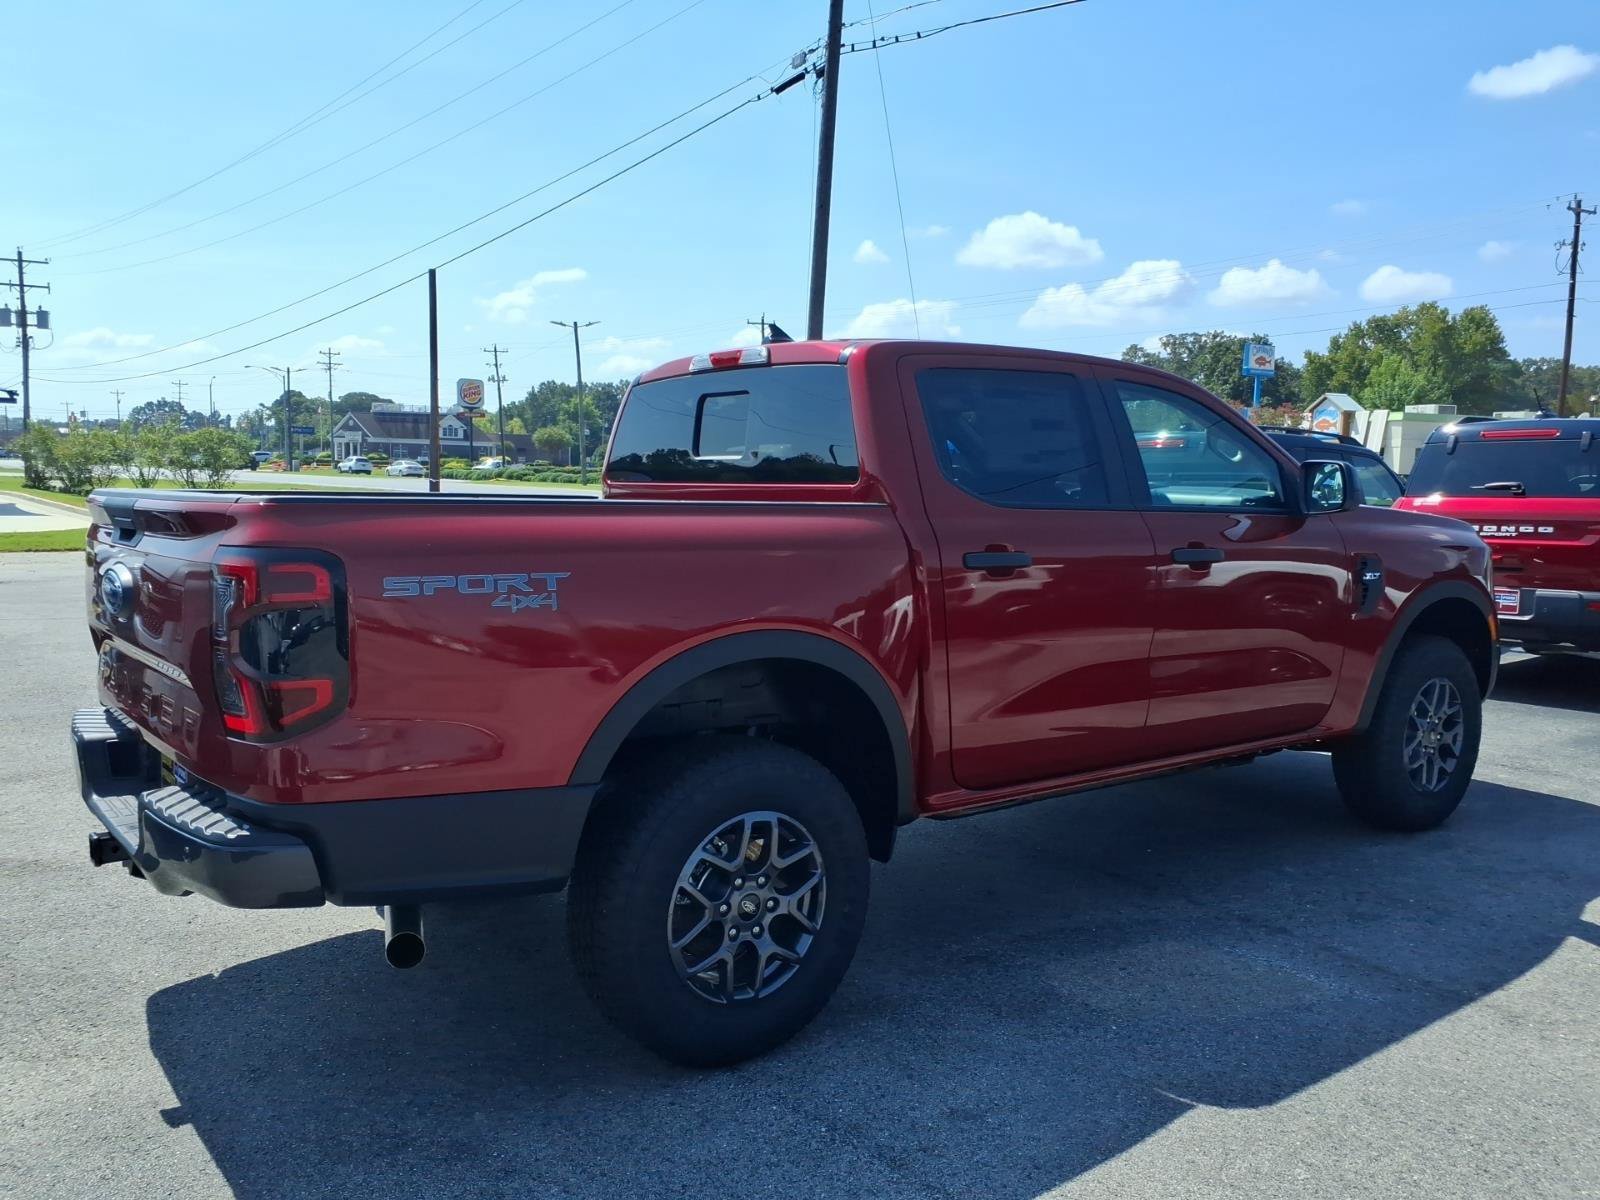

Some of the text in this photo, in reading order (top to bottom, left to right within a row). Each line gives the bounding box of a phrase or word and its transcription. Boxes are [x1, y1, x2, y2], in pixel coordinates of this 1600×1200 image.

[463, 390, 481, 399] KING
[1472, 525, 1554, 533] ONCO
[382, 572, 571, 597] SPORT
